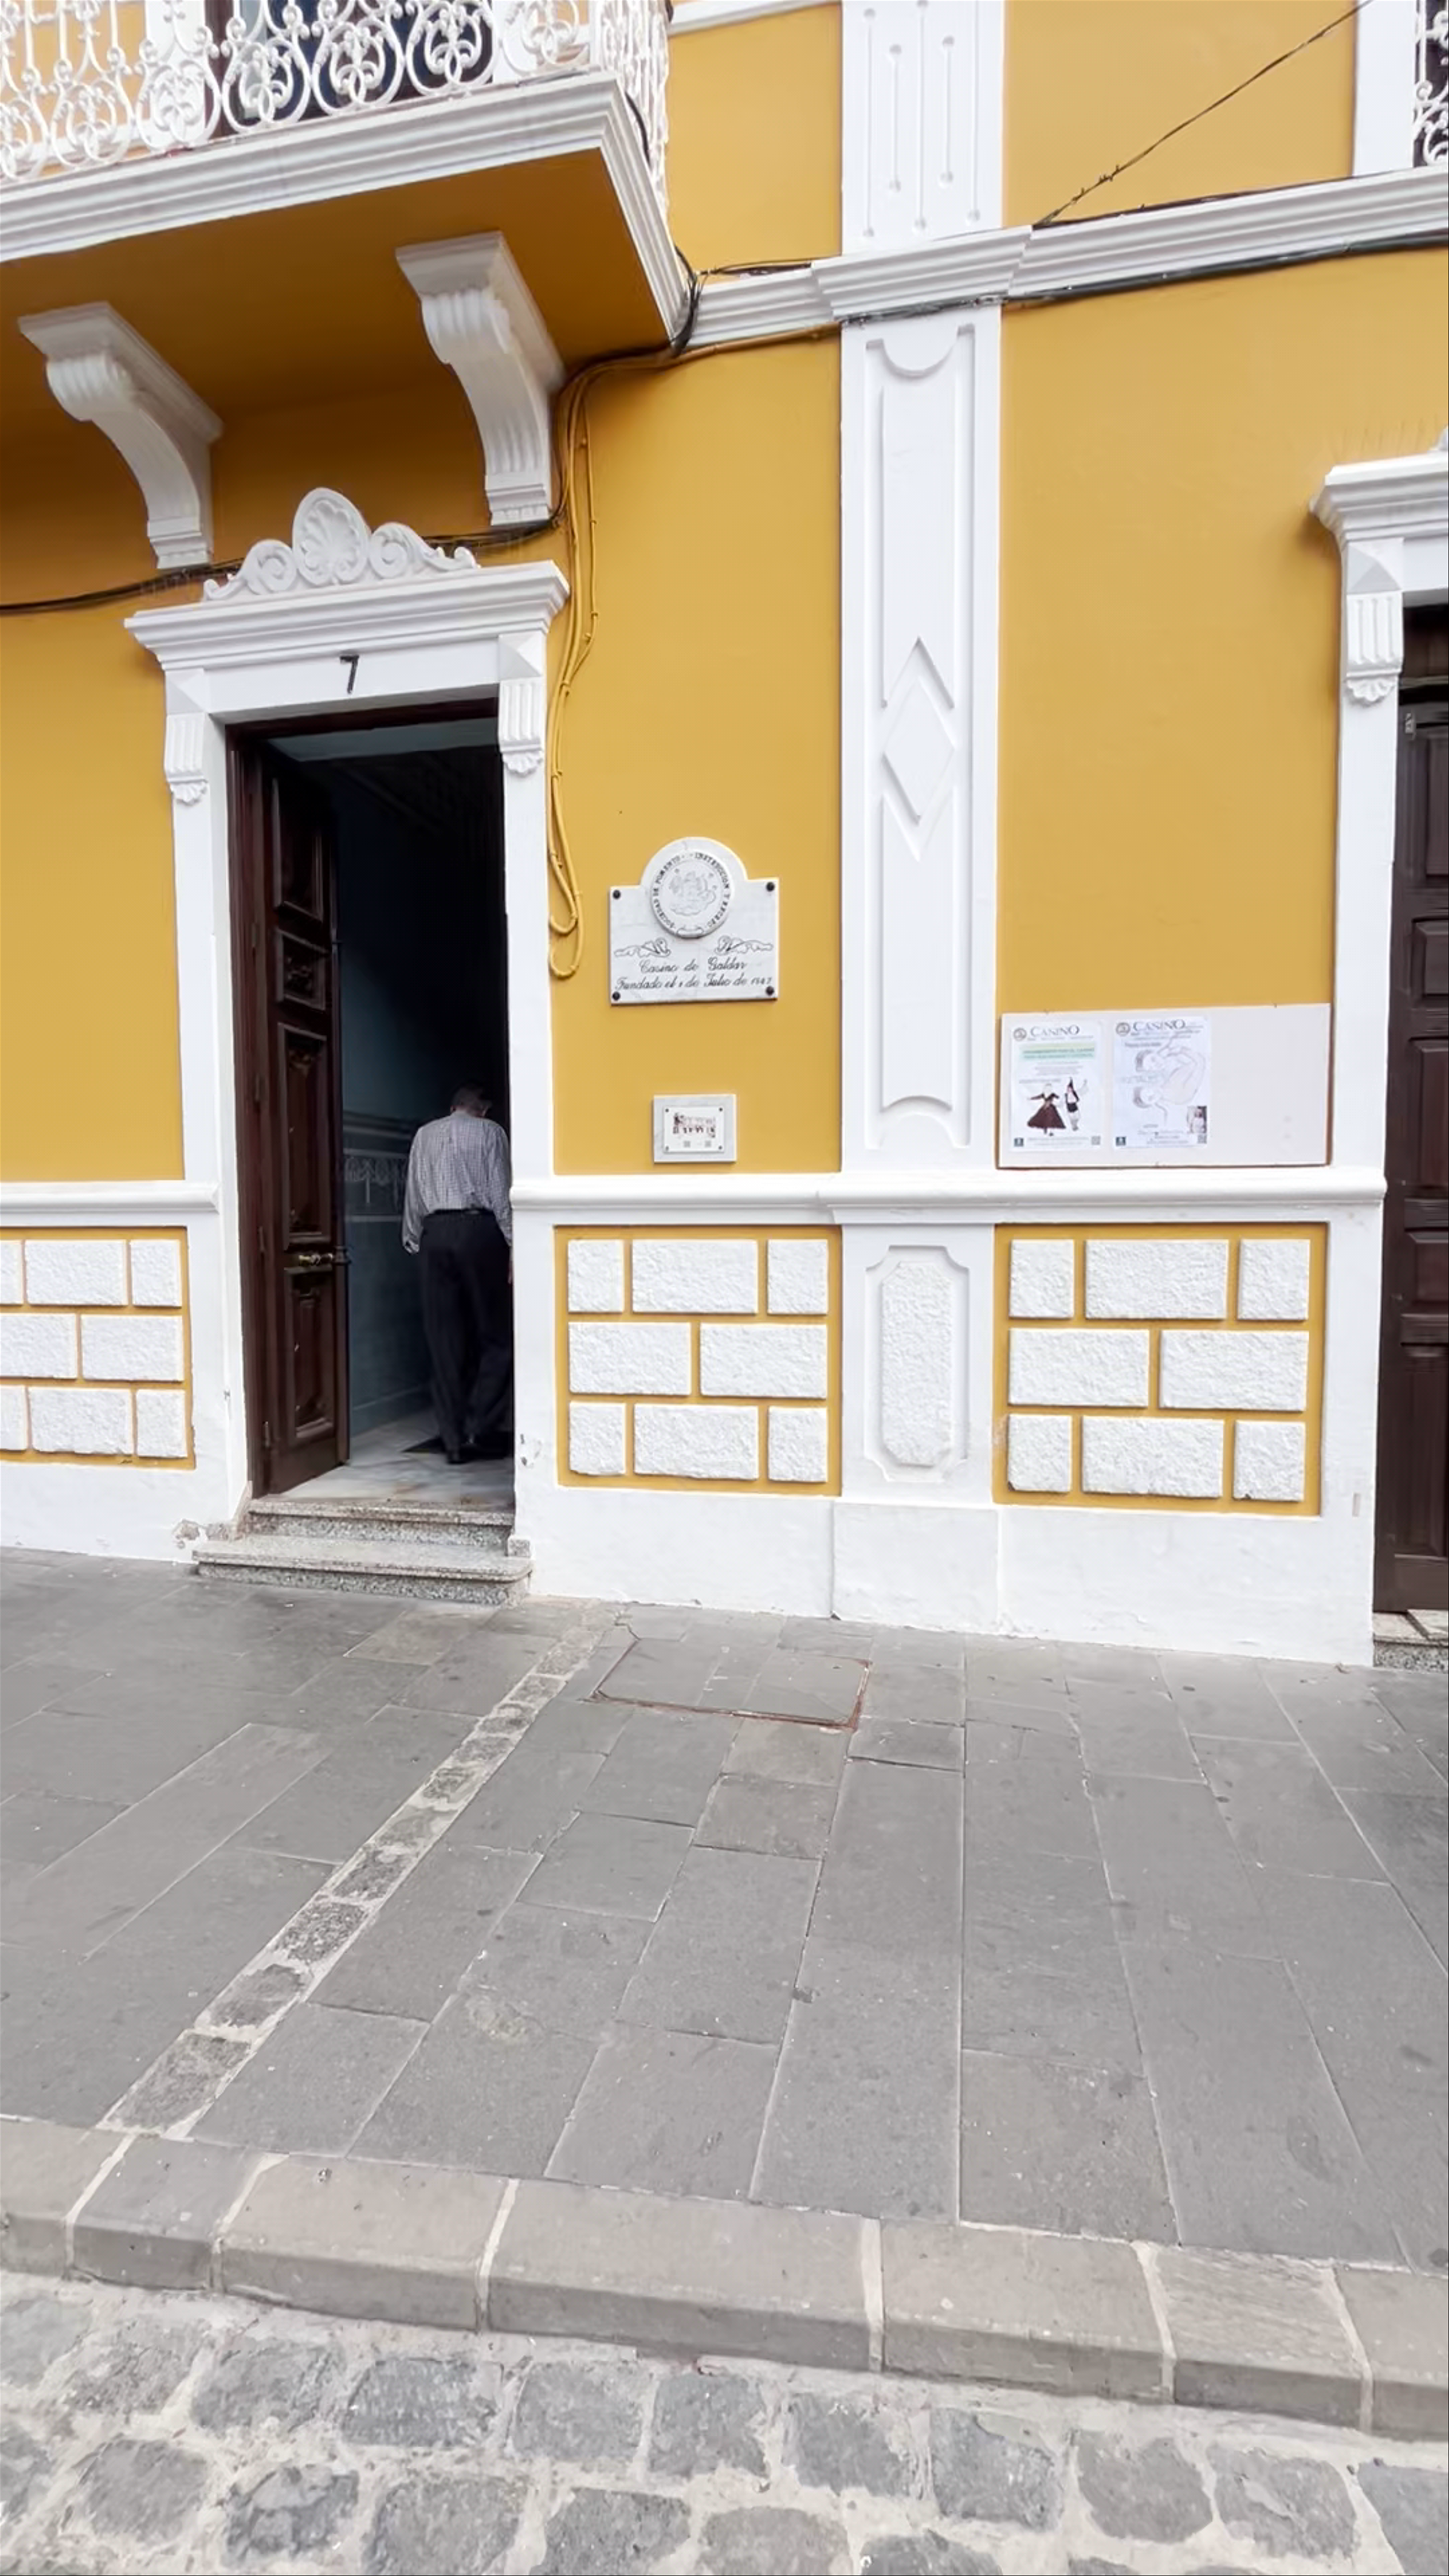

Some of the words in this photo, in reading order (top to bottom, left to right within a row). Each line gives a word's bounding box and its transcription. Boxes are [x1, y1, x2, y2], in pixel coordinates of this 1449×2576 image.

[340, 655, 360, 694] 7
[639, 959, 679, 973] Casino
[684, 958, 699, 971] de
[615, 976, 663, 990] Fundado
[685, 975, 699, 988] de
[703, 973, 731, 987] Julio
[733, 972, 748, 986] de
[1030, 1024, 1080, 1037] CASINO
